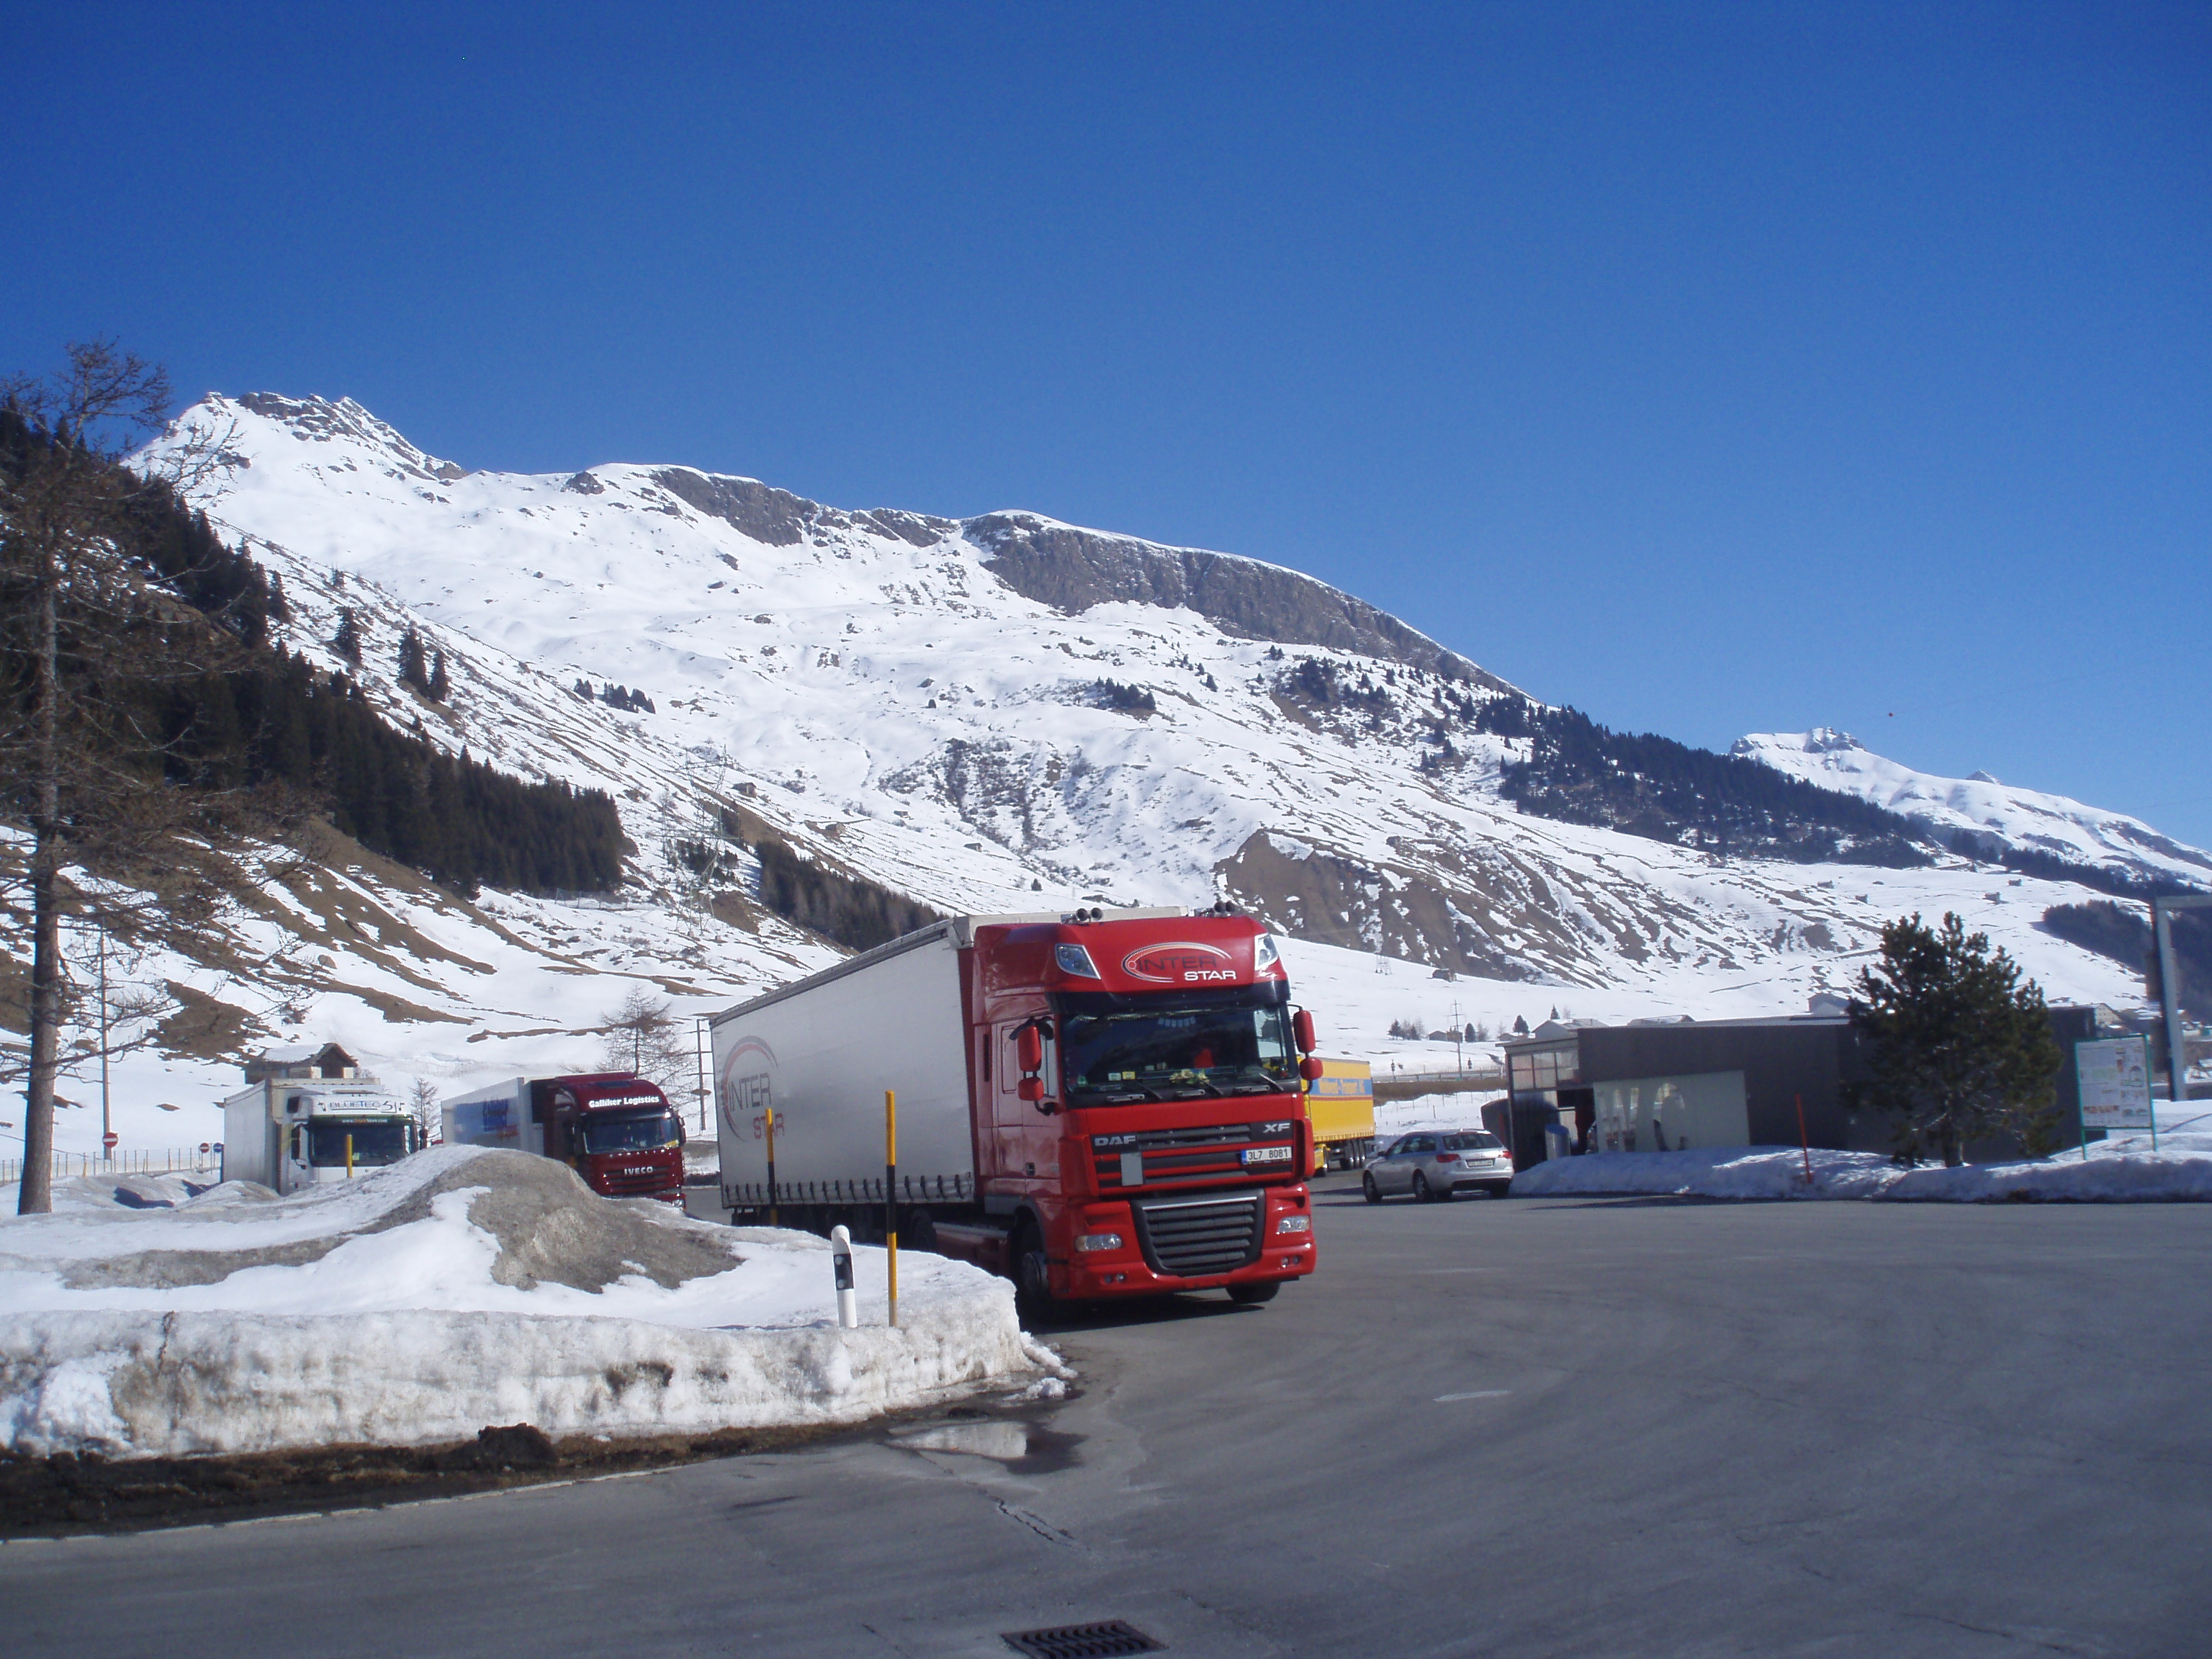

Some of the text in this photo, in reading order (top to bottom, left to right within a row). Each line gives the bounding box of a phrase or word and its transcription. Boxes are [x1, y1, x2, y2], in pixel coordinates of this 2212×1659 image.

[1137, 956, 1217, 972] INTER
[1184, 970, 1237, 981] STAR
[728, 1072, 771, 1112] INTER
[588, 1095, 660, 1108] Galliker Logistics
[1596, 1082, 1689, 1152] WC
[1262, 1123, 1291, 1133] XF
[1094, 1135, 1136, 1146] DAF
[1248, 1148, 1288, 1160] 3L7 8081
[624, 1166, 654, 1175] IVECO
